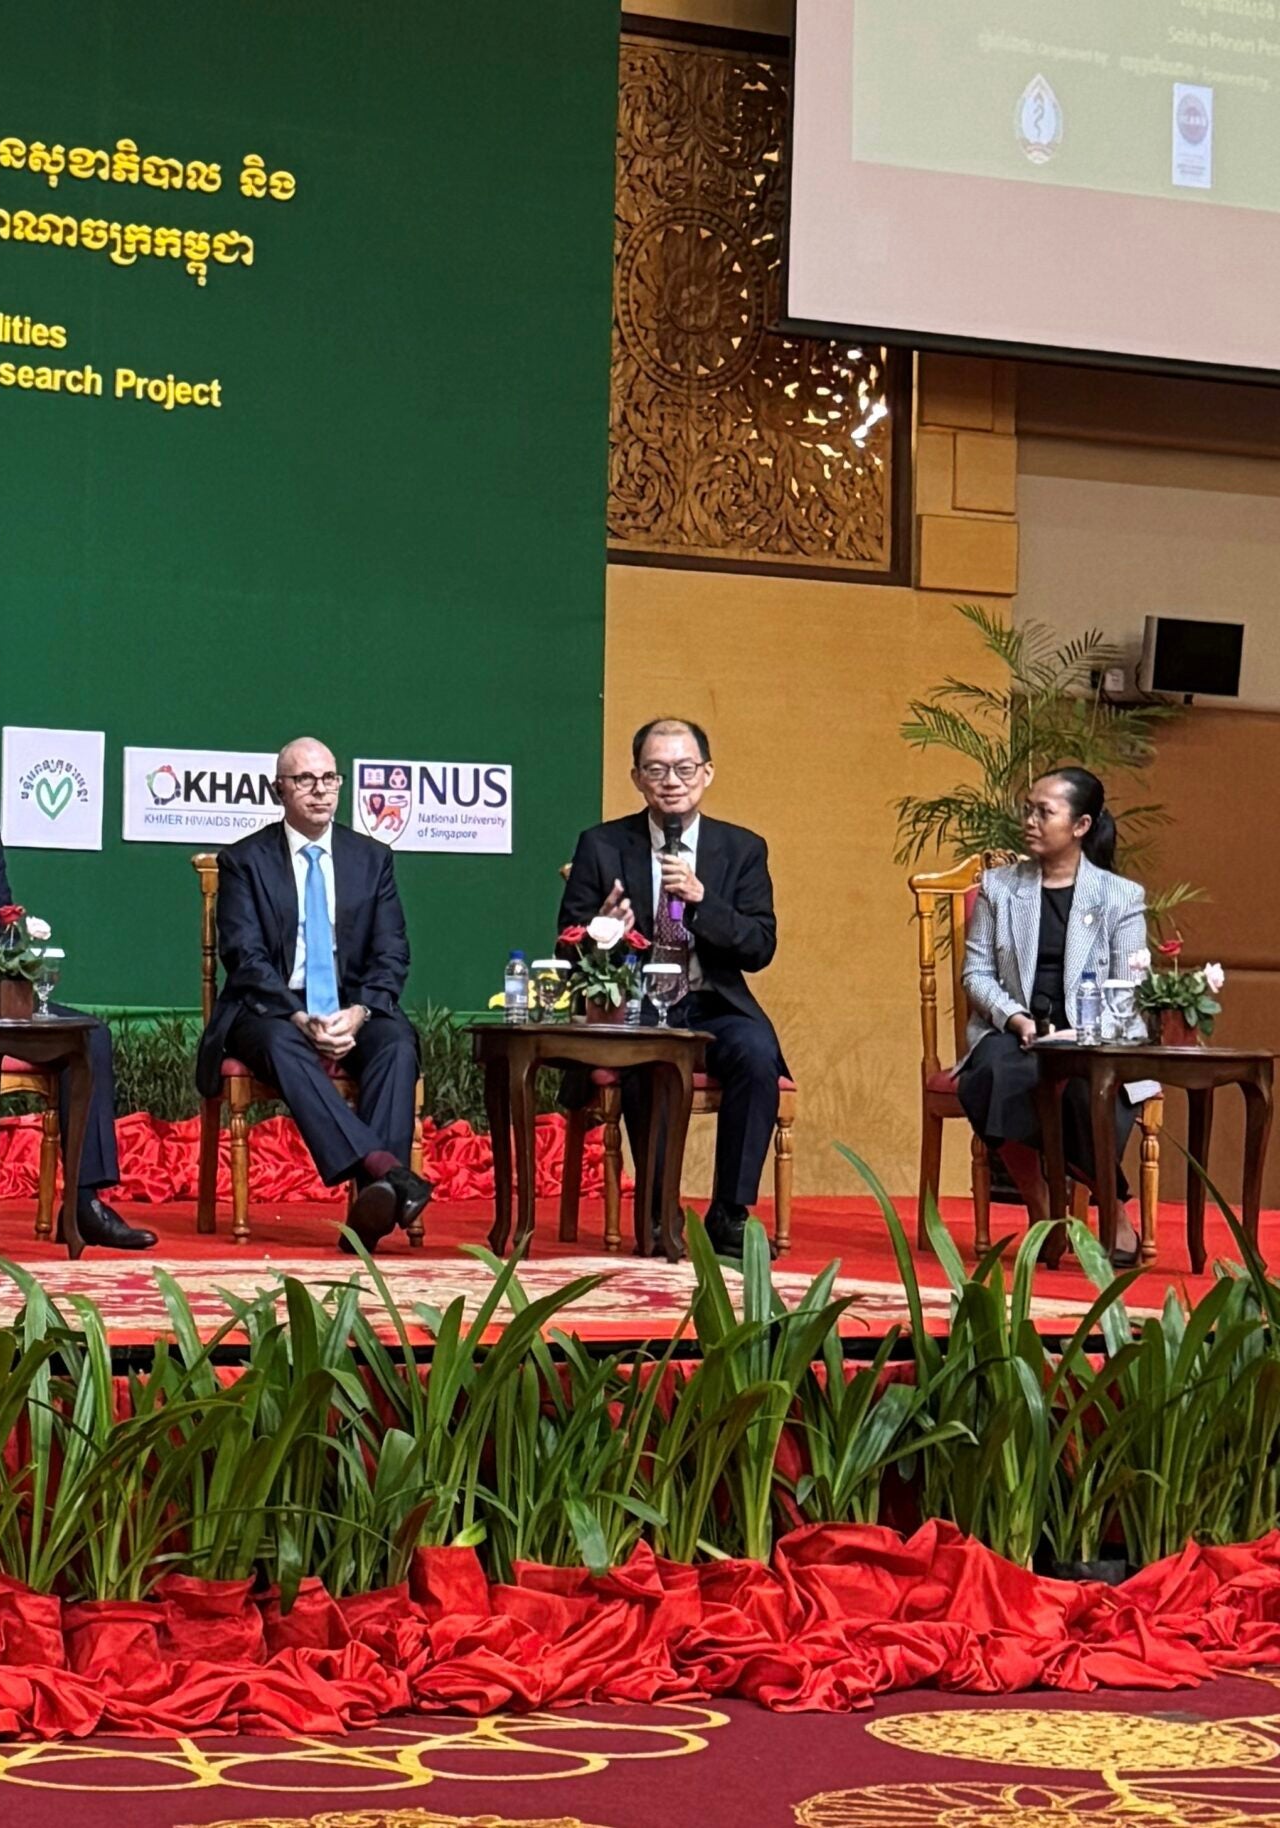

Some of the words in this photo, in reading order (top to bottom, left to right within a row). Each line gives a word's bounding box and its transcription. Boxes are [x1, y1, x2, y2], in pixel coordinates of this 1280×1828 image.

[239, 154, 296, 200] និង
[116, 369, 222, 410] Project
[418, 766, 508, 808] NUS
[144, 814, 183, 826] KHMER
[185, 816, 231, 827] HIV/AIDS
[232, 818, 256, 828] NGO
[417, 827, 428, 837] of
[430, 828, 478, 840] Singapore
[418, 813, 458, 824] National
[460, 814, 507, 828] University
